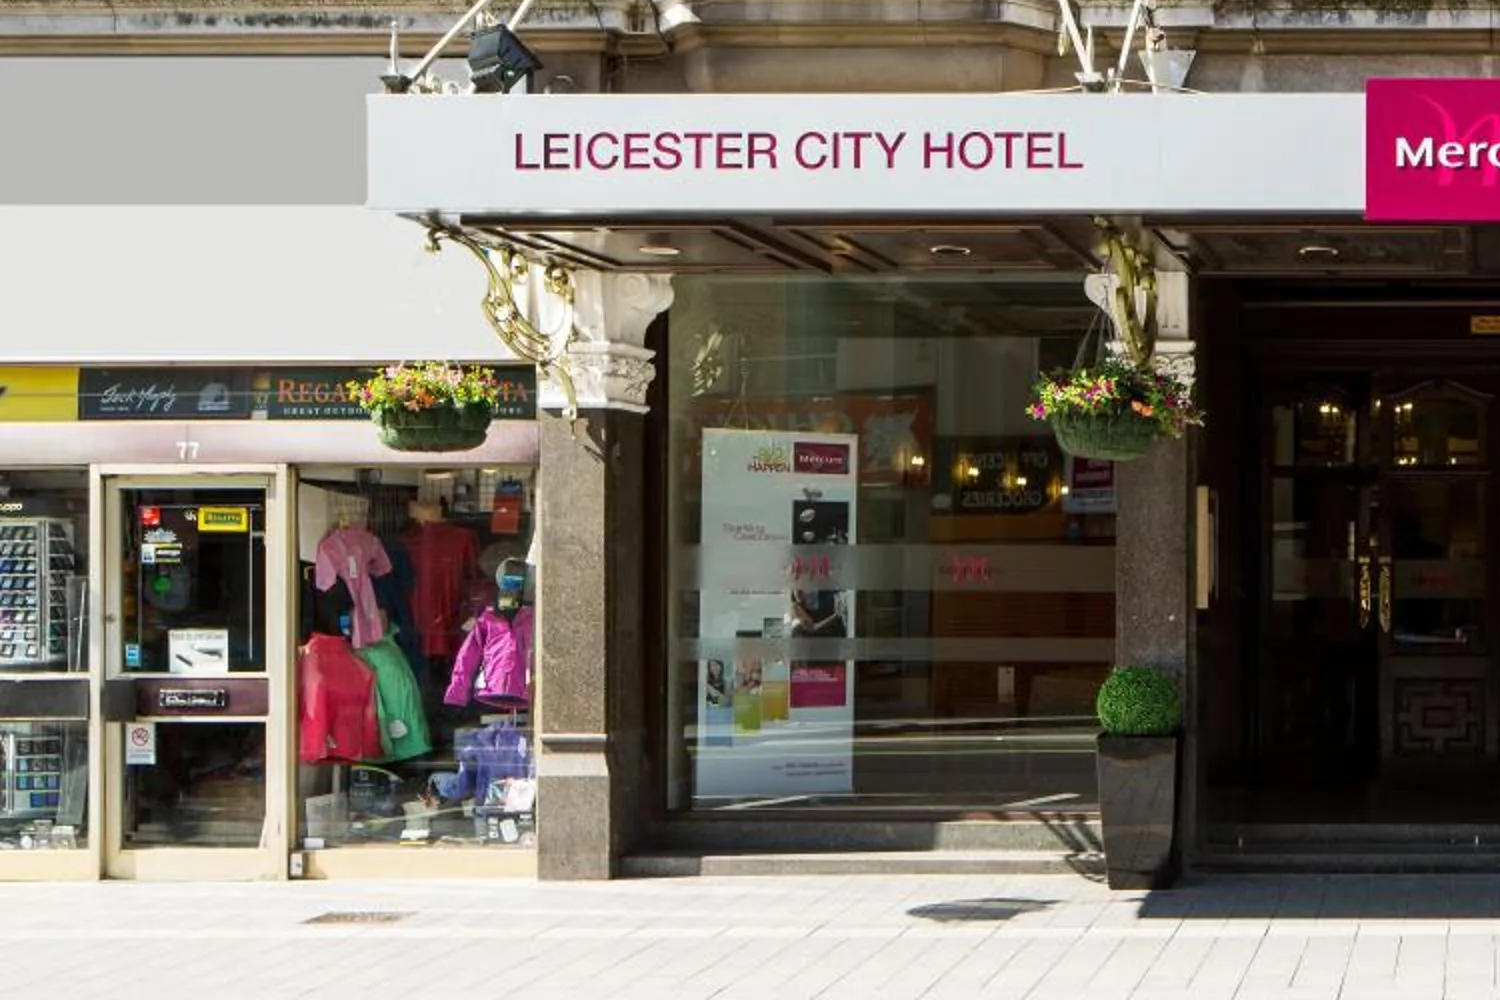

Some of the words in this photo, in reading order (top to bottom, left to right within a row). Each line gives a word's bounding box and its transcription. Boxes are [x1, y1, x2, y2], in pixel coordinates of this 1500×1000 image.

[514, 132, 779, 170] LEICESTER
[795, 131, 907, 171] CITY
[923, 131, 1084, 171] HOTEL
[176, 441, 199, 459] 77
